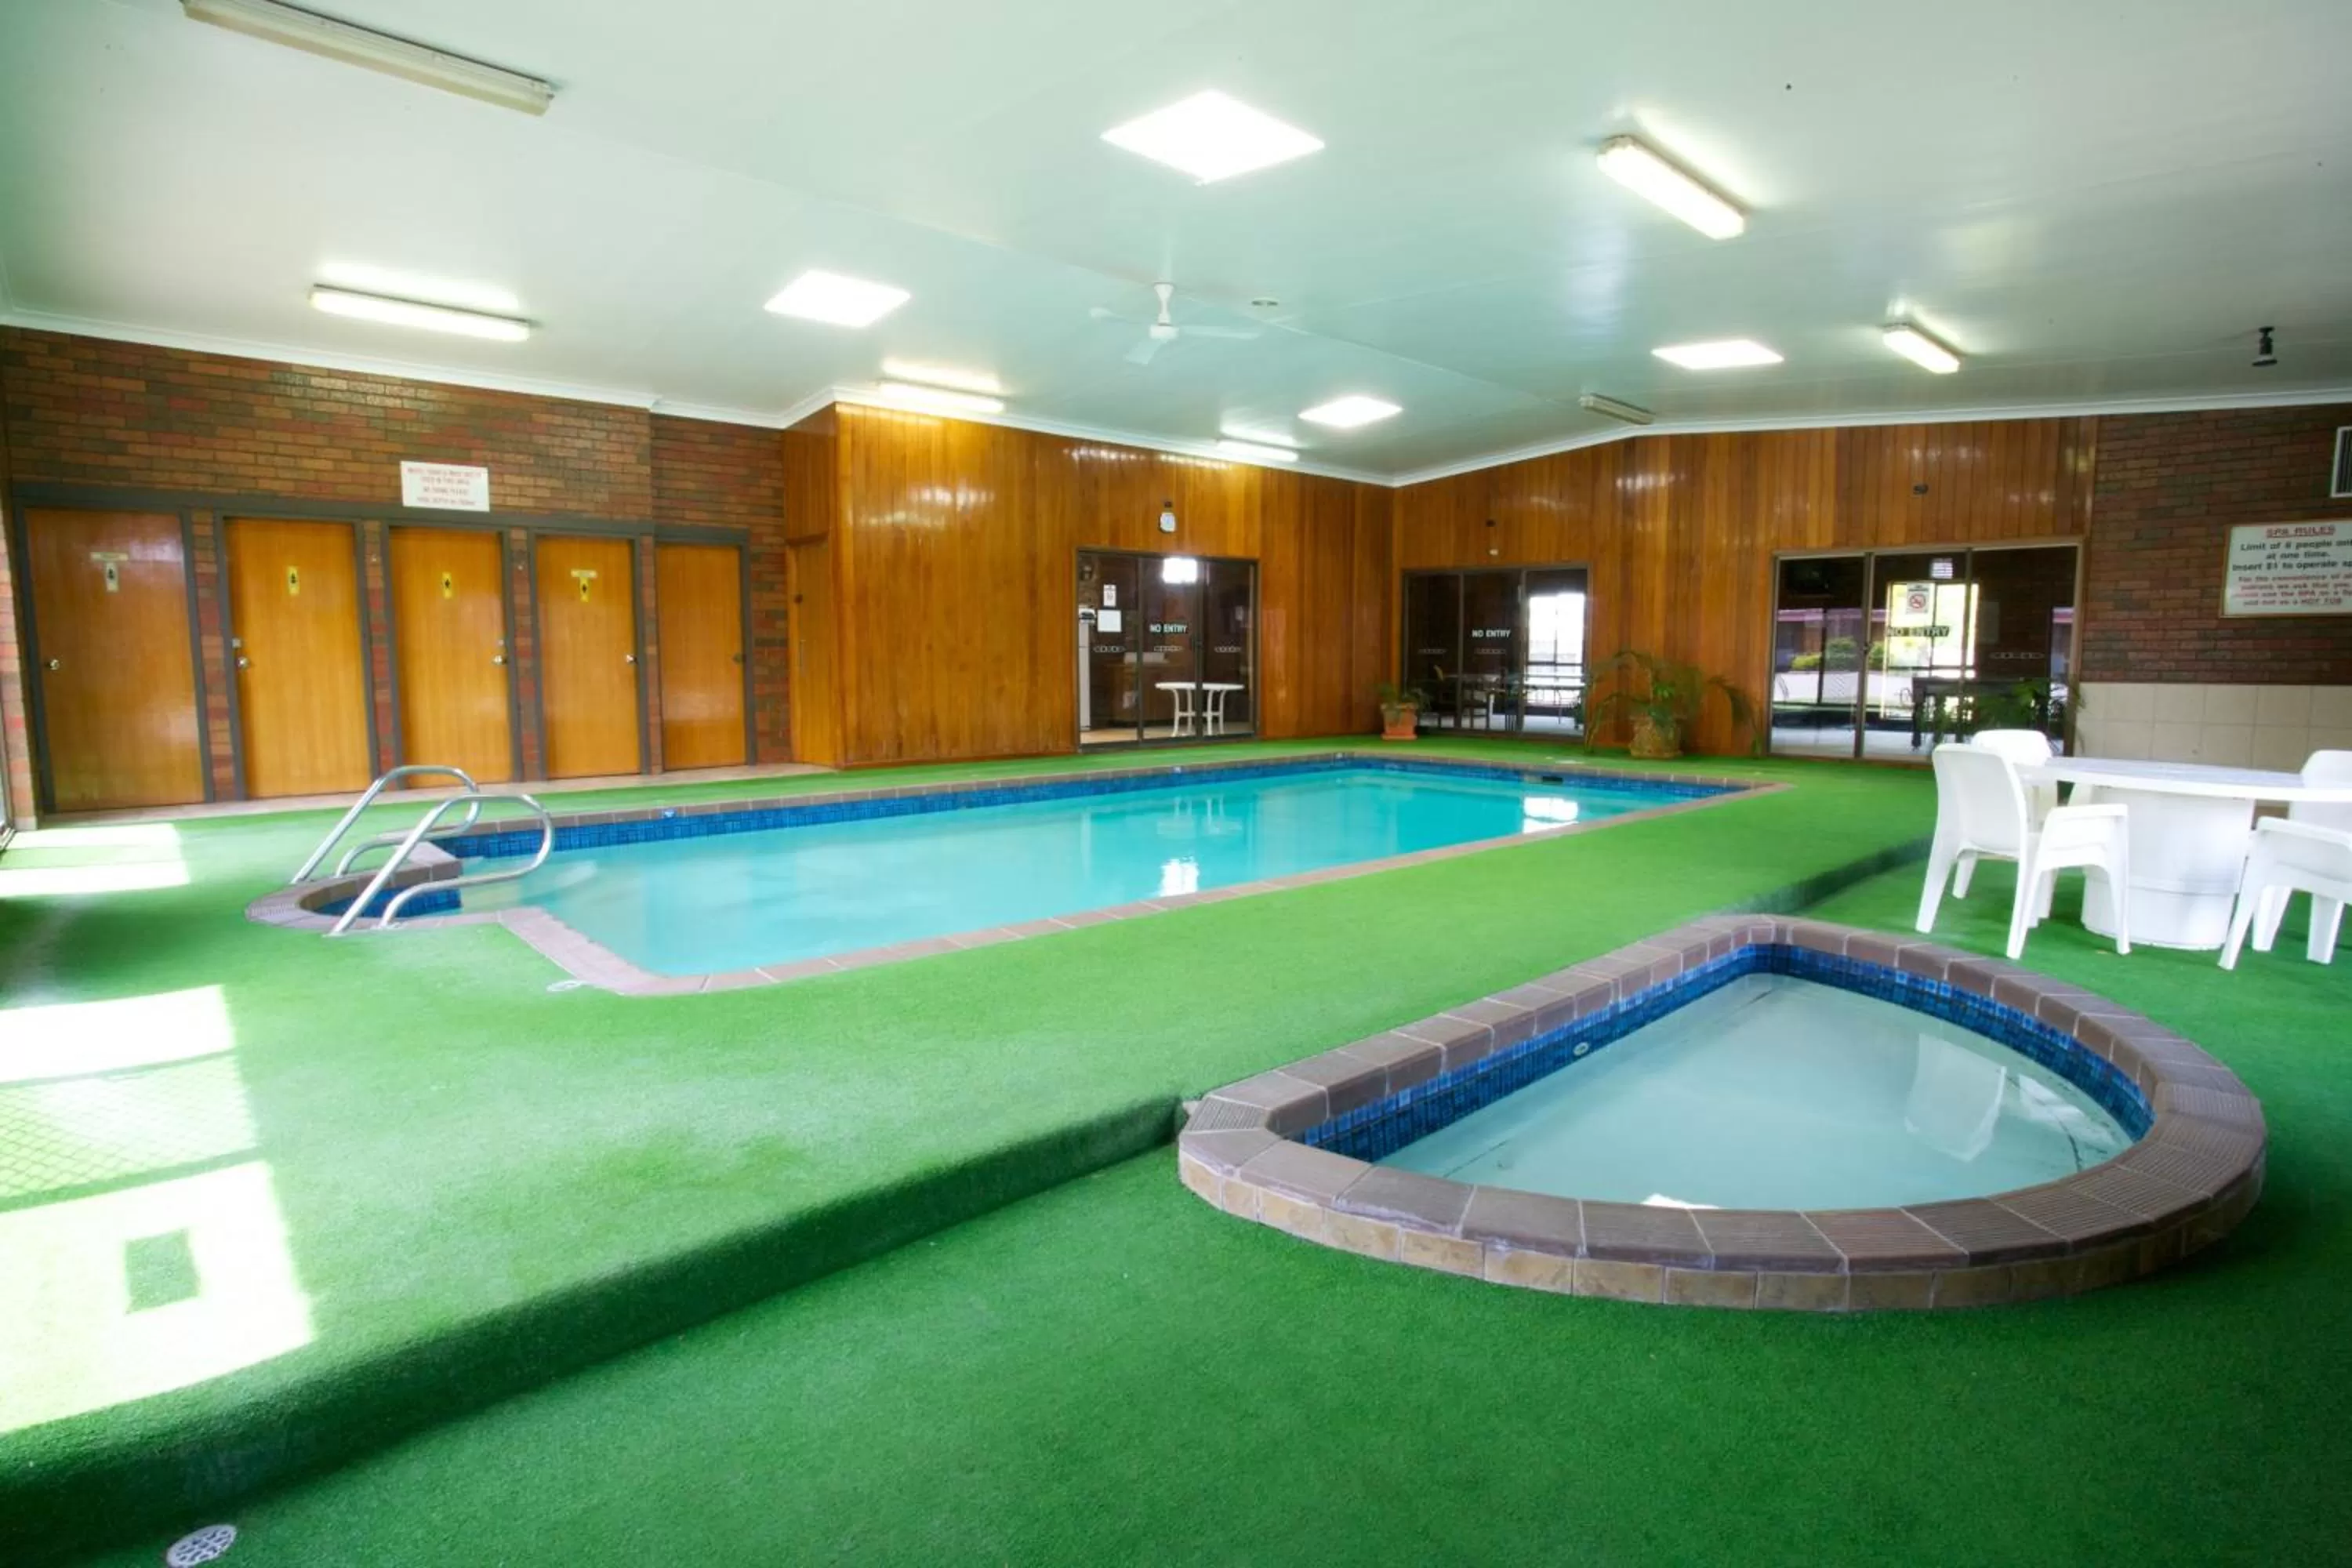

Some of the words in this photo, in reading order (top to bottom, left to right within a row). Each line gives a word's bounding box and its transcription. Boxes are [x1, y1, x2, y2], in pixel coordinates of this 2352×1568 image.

[2296, 539, 2332, 550] people
[2296, 560, 2337, 570] operate
[1149, 623, 1161, 633] NO
[1163, 623, 1187, 633] ENTRY
[1486, 629, 1511, 637] ENTRY
